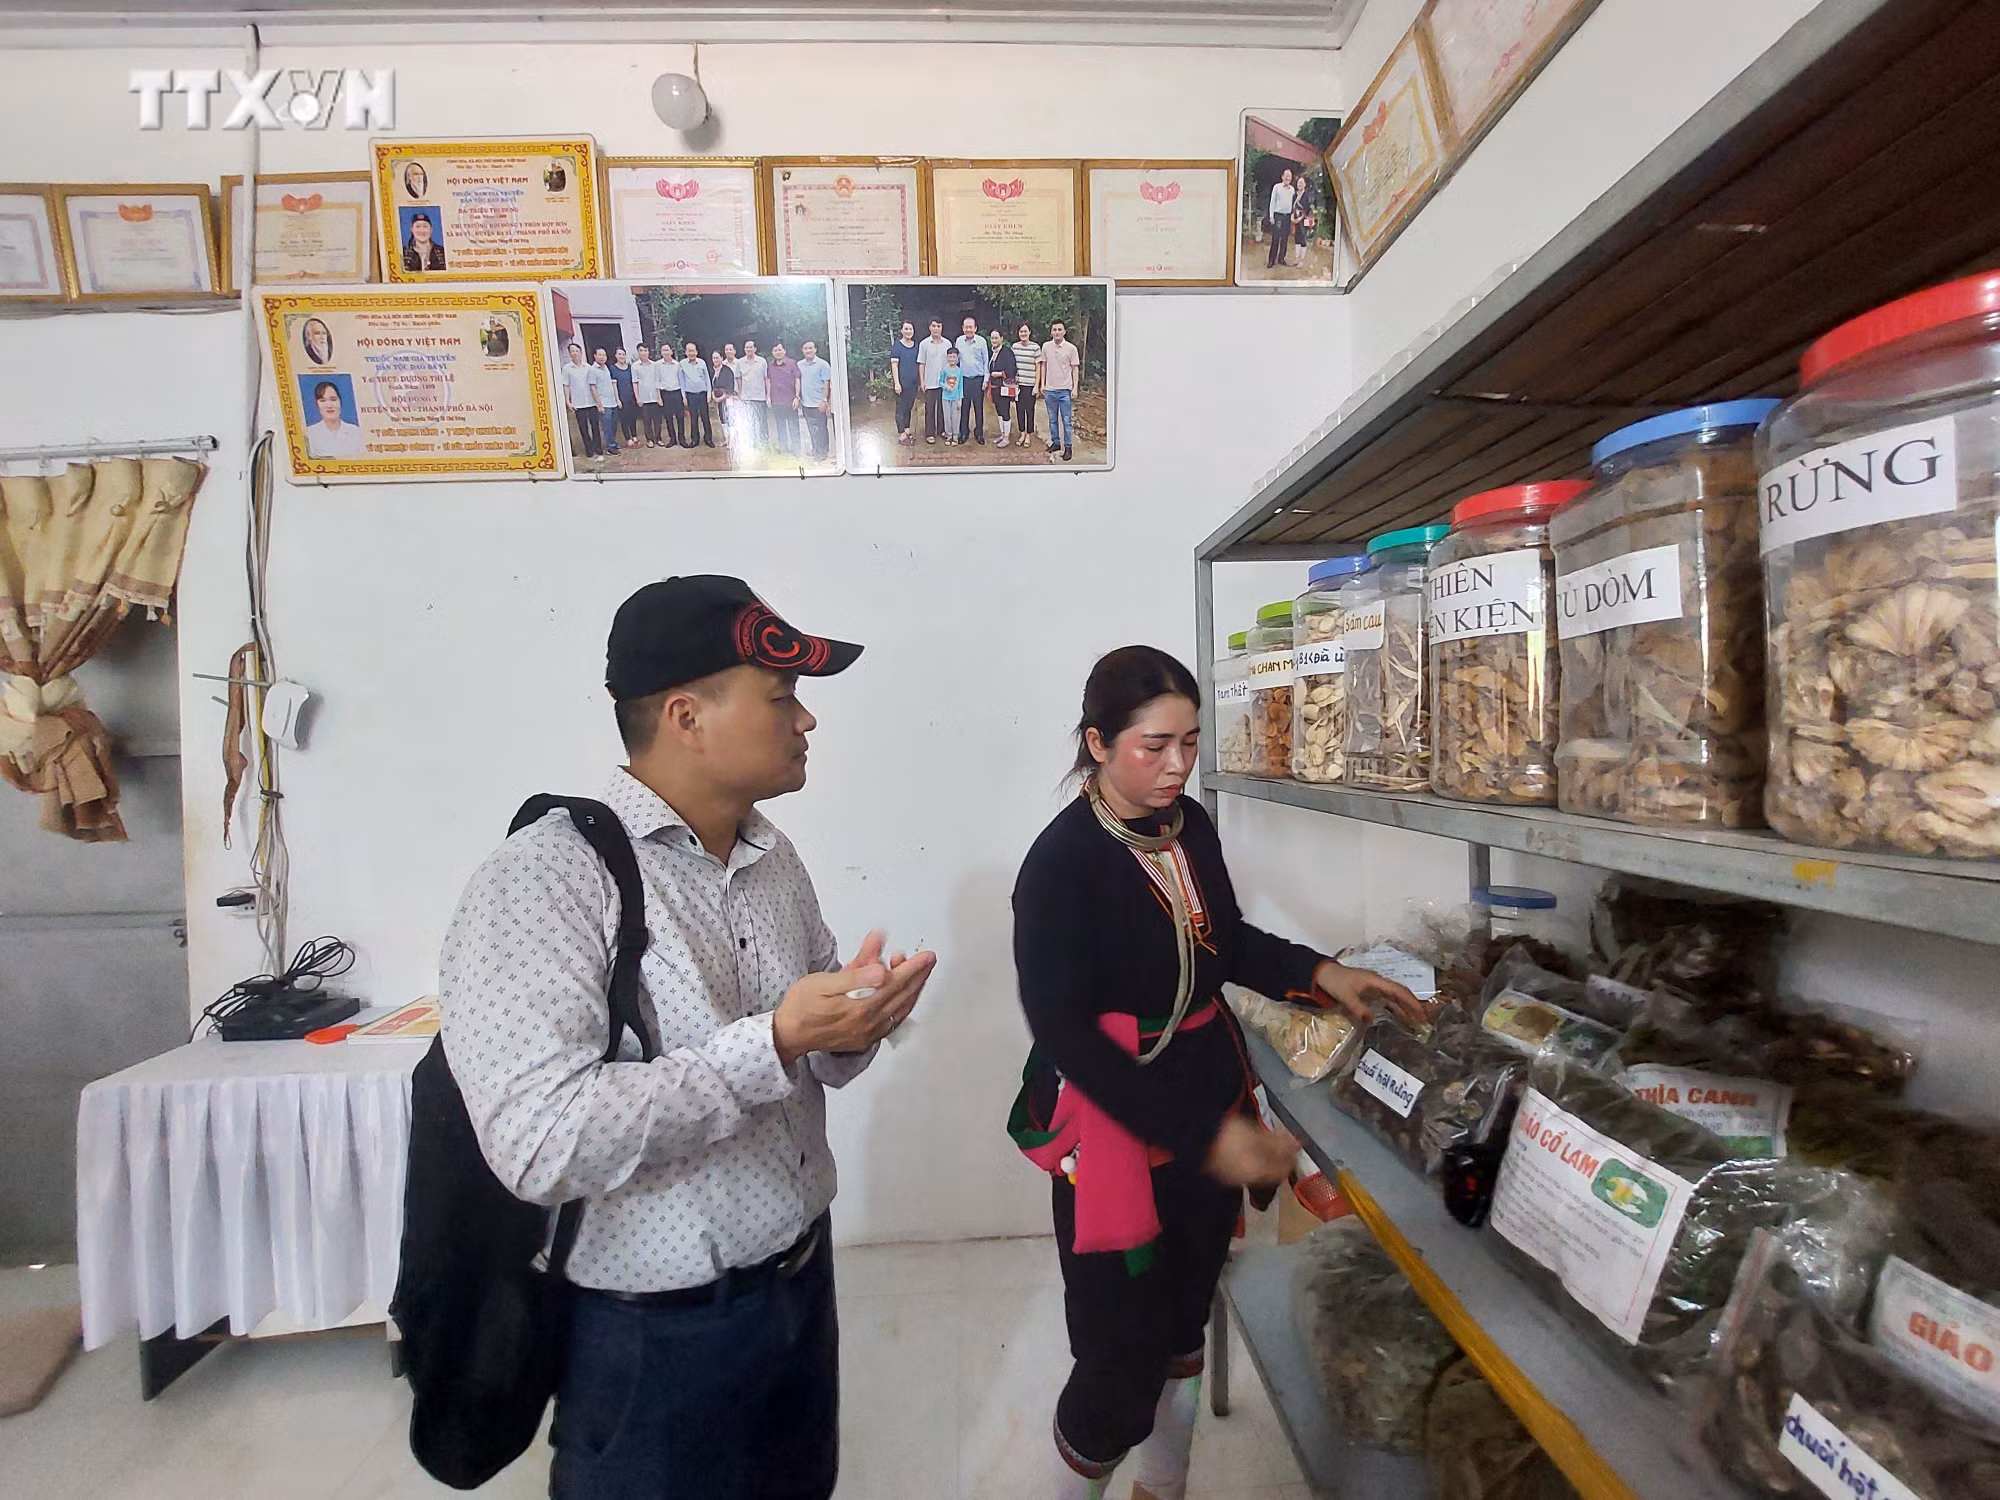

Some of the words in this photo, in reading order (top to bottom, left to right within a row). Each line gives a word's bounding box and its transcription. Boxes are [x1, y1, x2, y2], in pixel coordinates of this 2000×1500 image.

[356, 338, 374, 348] HỘI
[416, 336, 437, 348] VIỆT
[440, 338, 462, 346] NAM
[1765, 436, 1944, 524] RỪNG
[1584, 567, 1658, 614] DÒM
[1453, 598, 1537, 634] KIỆN
[1560, 1142, 1600, 1179] LAM
